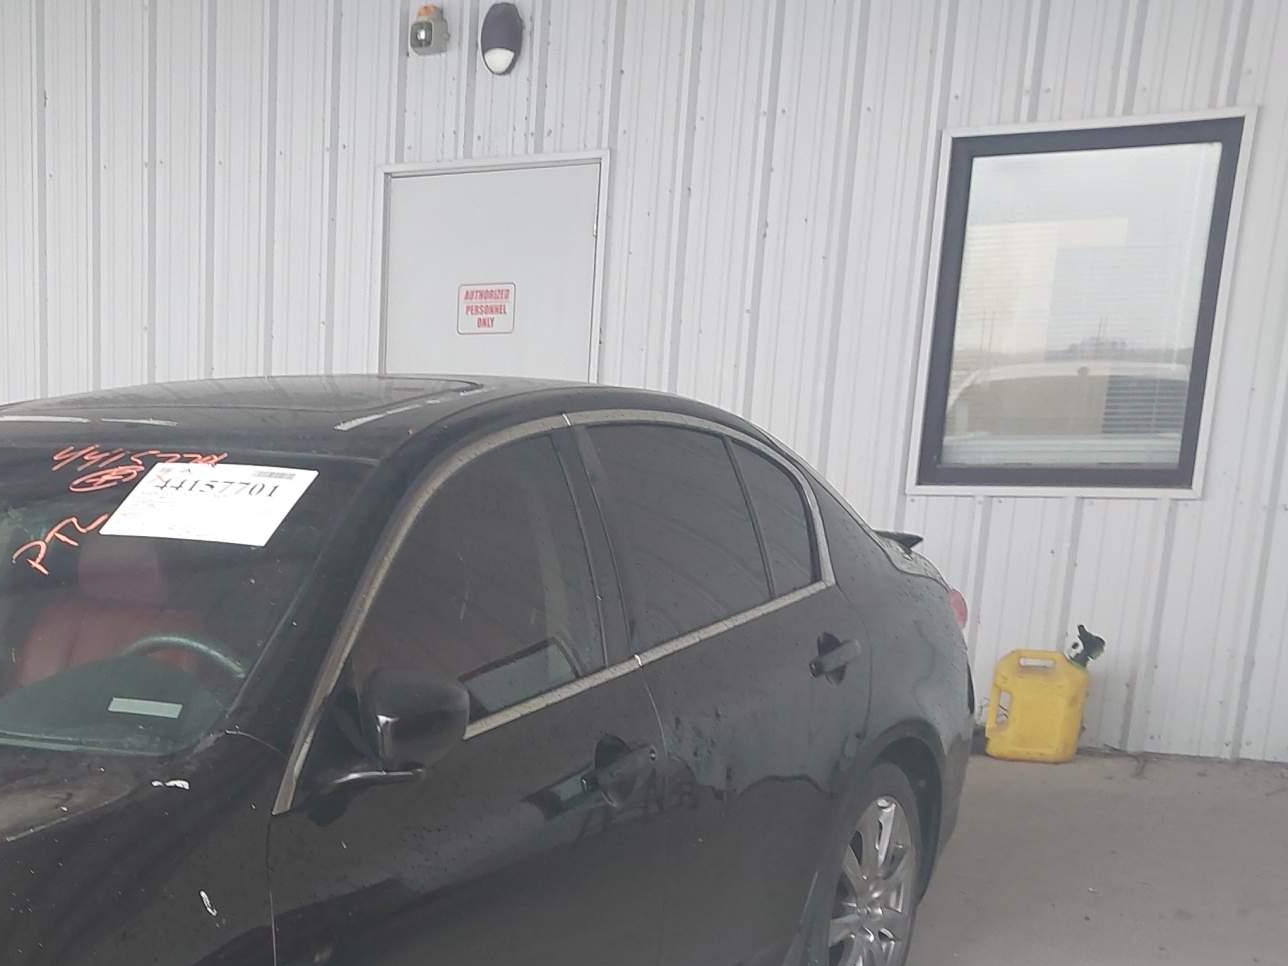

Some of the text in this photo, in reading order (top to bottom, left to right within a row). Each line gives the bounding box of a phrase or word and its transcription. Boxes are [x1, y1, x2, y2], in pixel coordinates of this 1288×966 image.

[464, 289, 510, 300] AUTHORIZED
[465, 304, 507, 315] PERSONNEL
[477, 317, 495, 328] ONLY
[154, 479, 281, 498] 44157701
